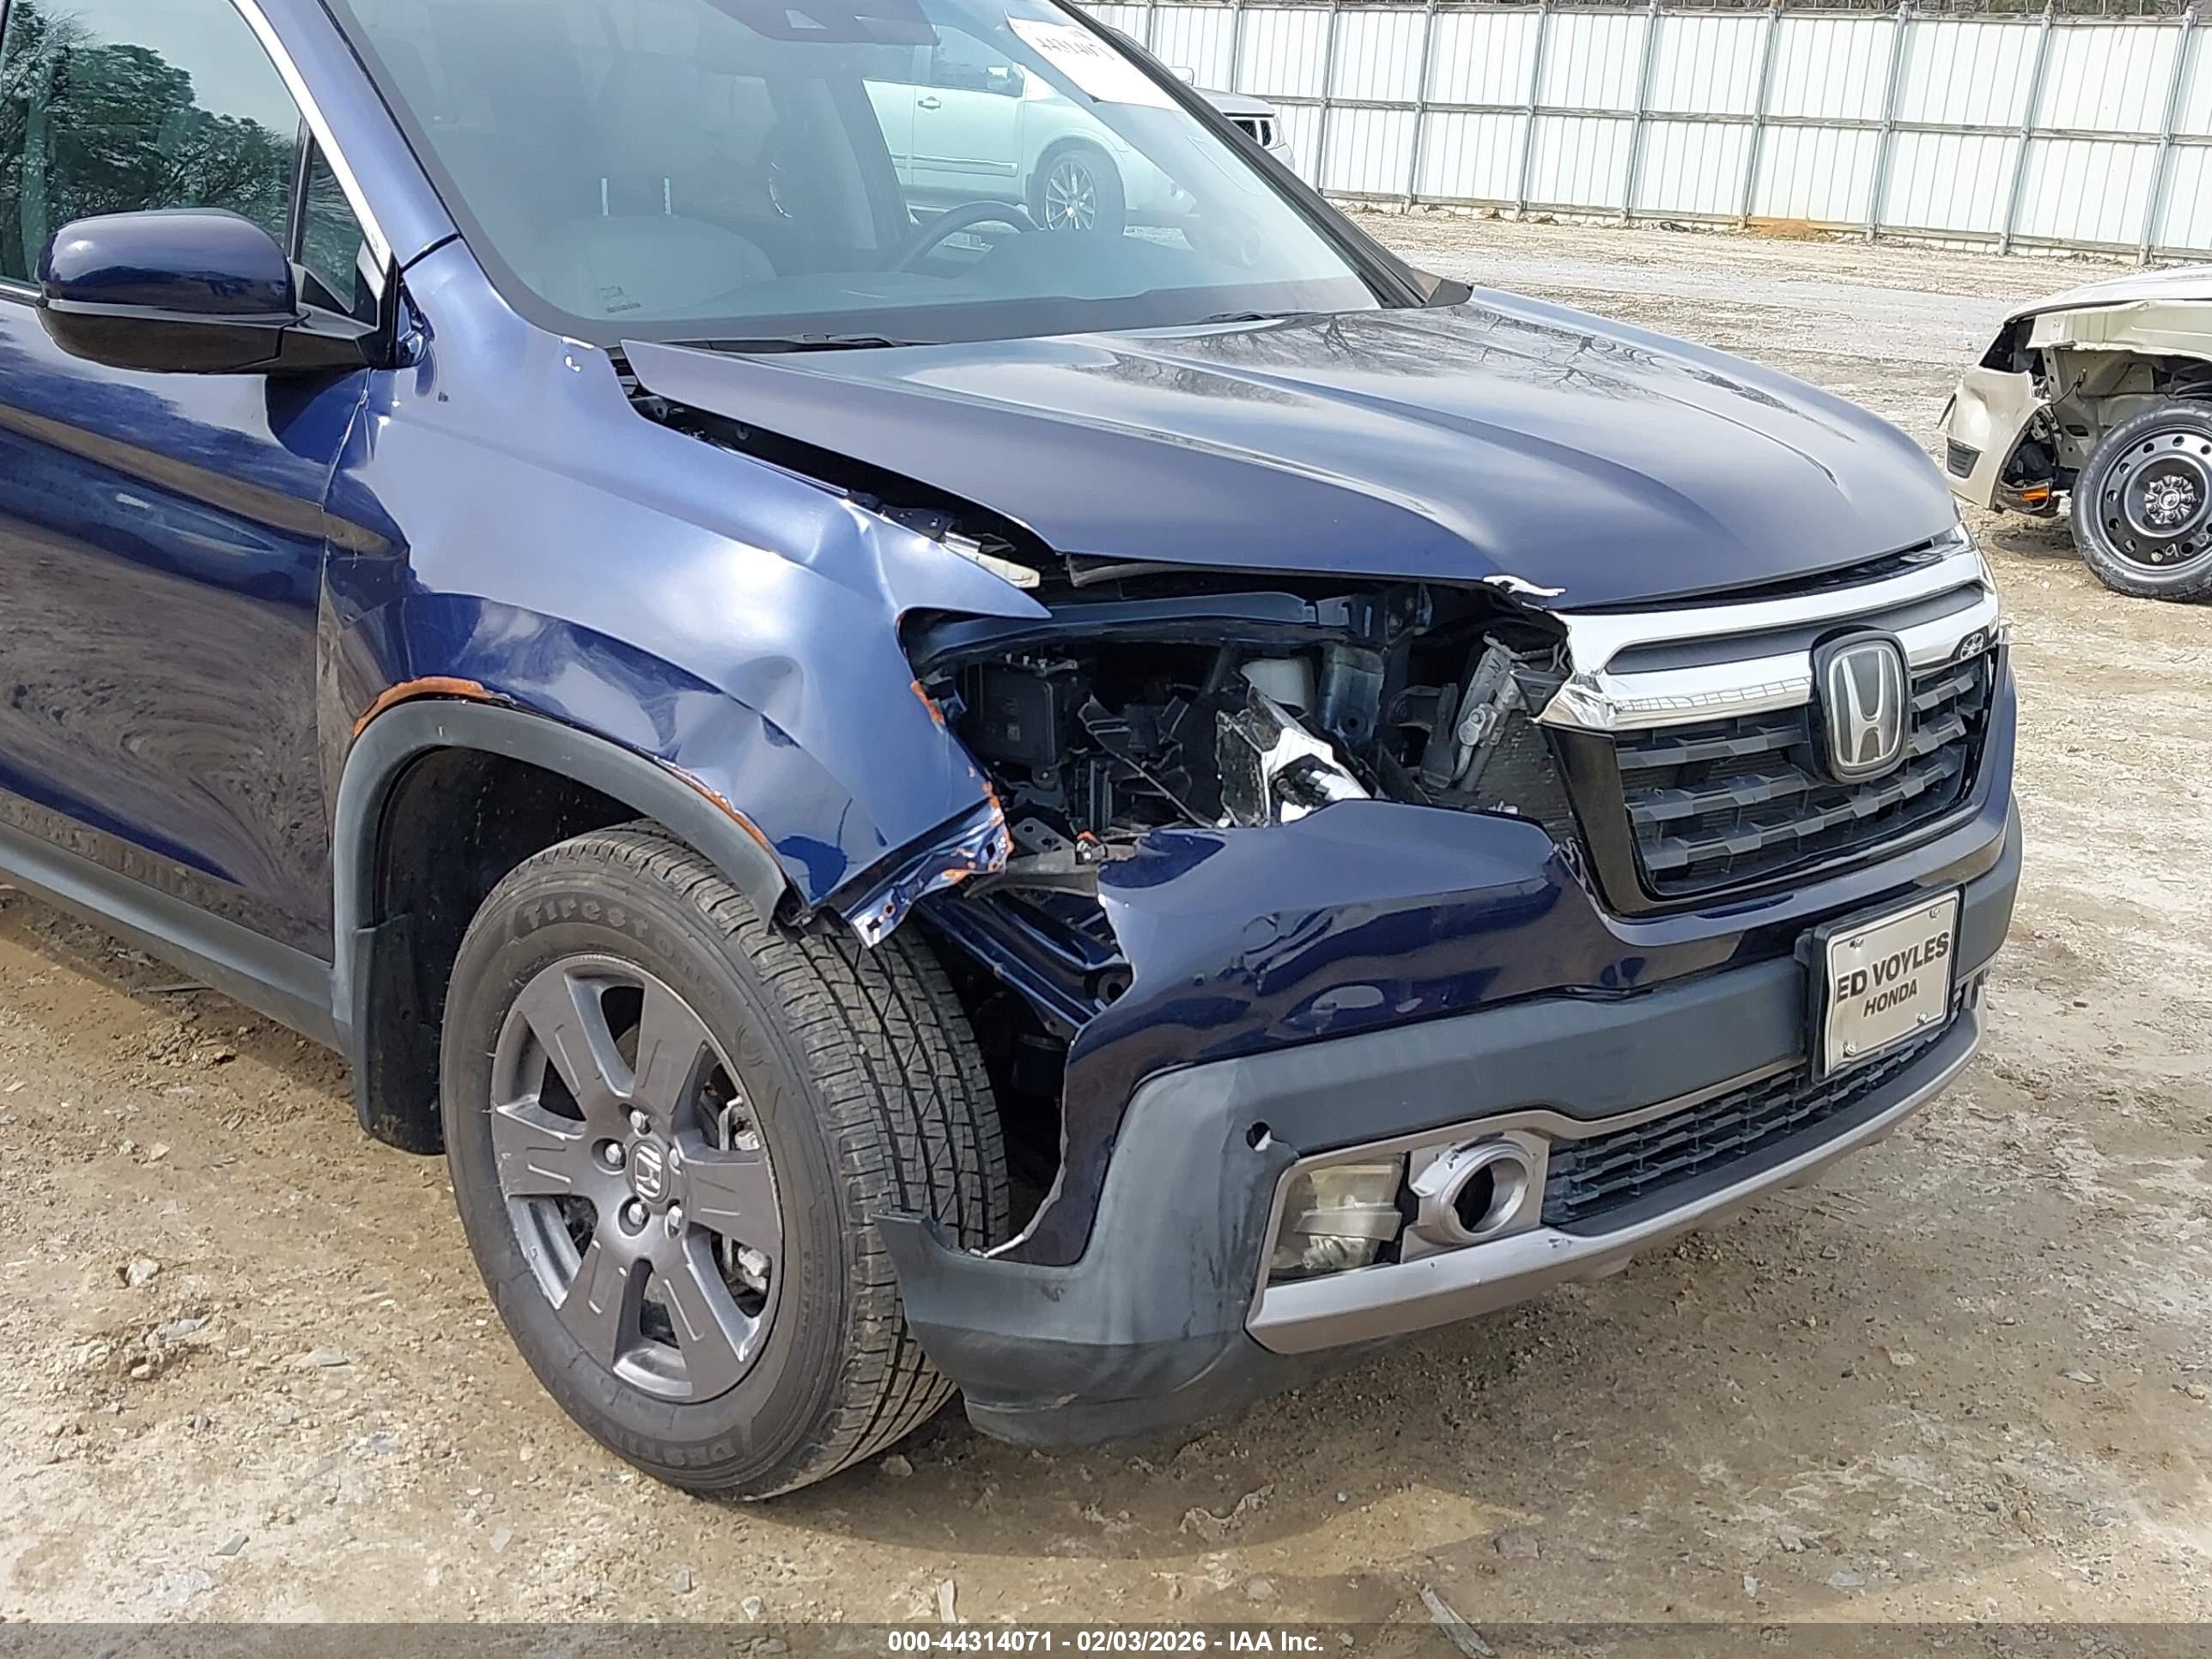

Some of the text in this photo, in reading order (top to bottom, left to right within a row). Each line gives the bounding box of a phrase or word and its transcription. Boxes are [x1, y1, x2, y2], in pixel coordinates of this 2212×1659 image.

[1835, 931, 1950, 1004] ED VOYLES
[1863, 978, 1917, 1018] HONDA
